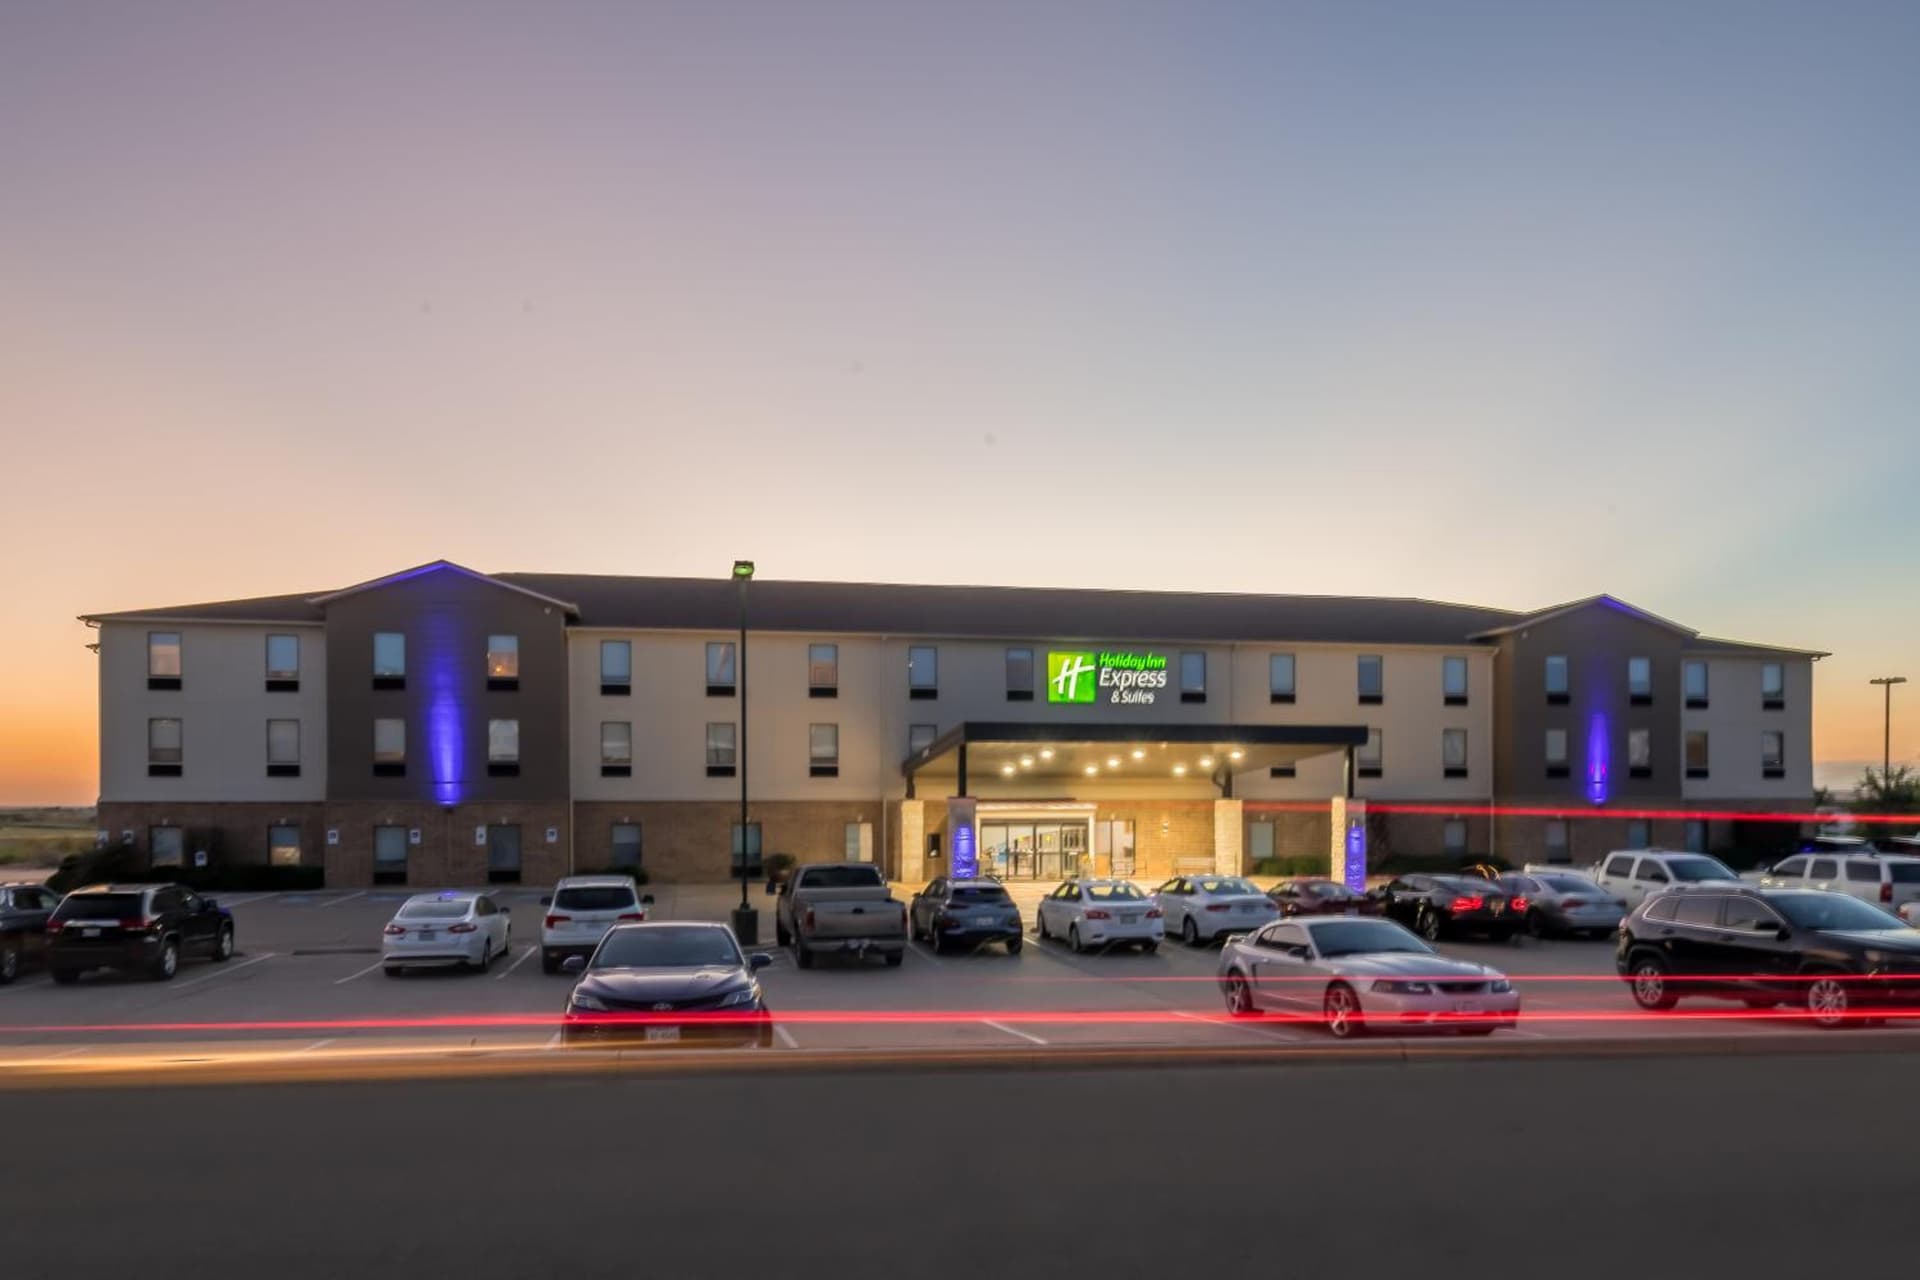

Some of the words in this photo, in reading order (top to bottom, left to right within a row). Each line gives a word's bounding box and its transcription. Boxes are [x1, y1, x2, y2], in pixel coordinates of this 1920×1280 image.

[1100, 652, 1145, 671] Holiday
[1147, 652, 1166, 669] Inn
[1099, 667, 1167, 691] Express
[1111, 690, 1120, 704] &
[1121, 690, 1155, 704] Suites
